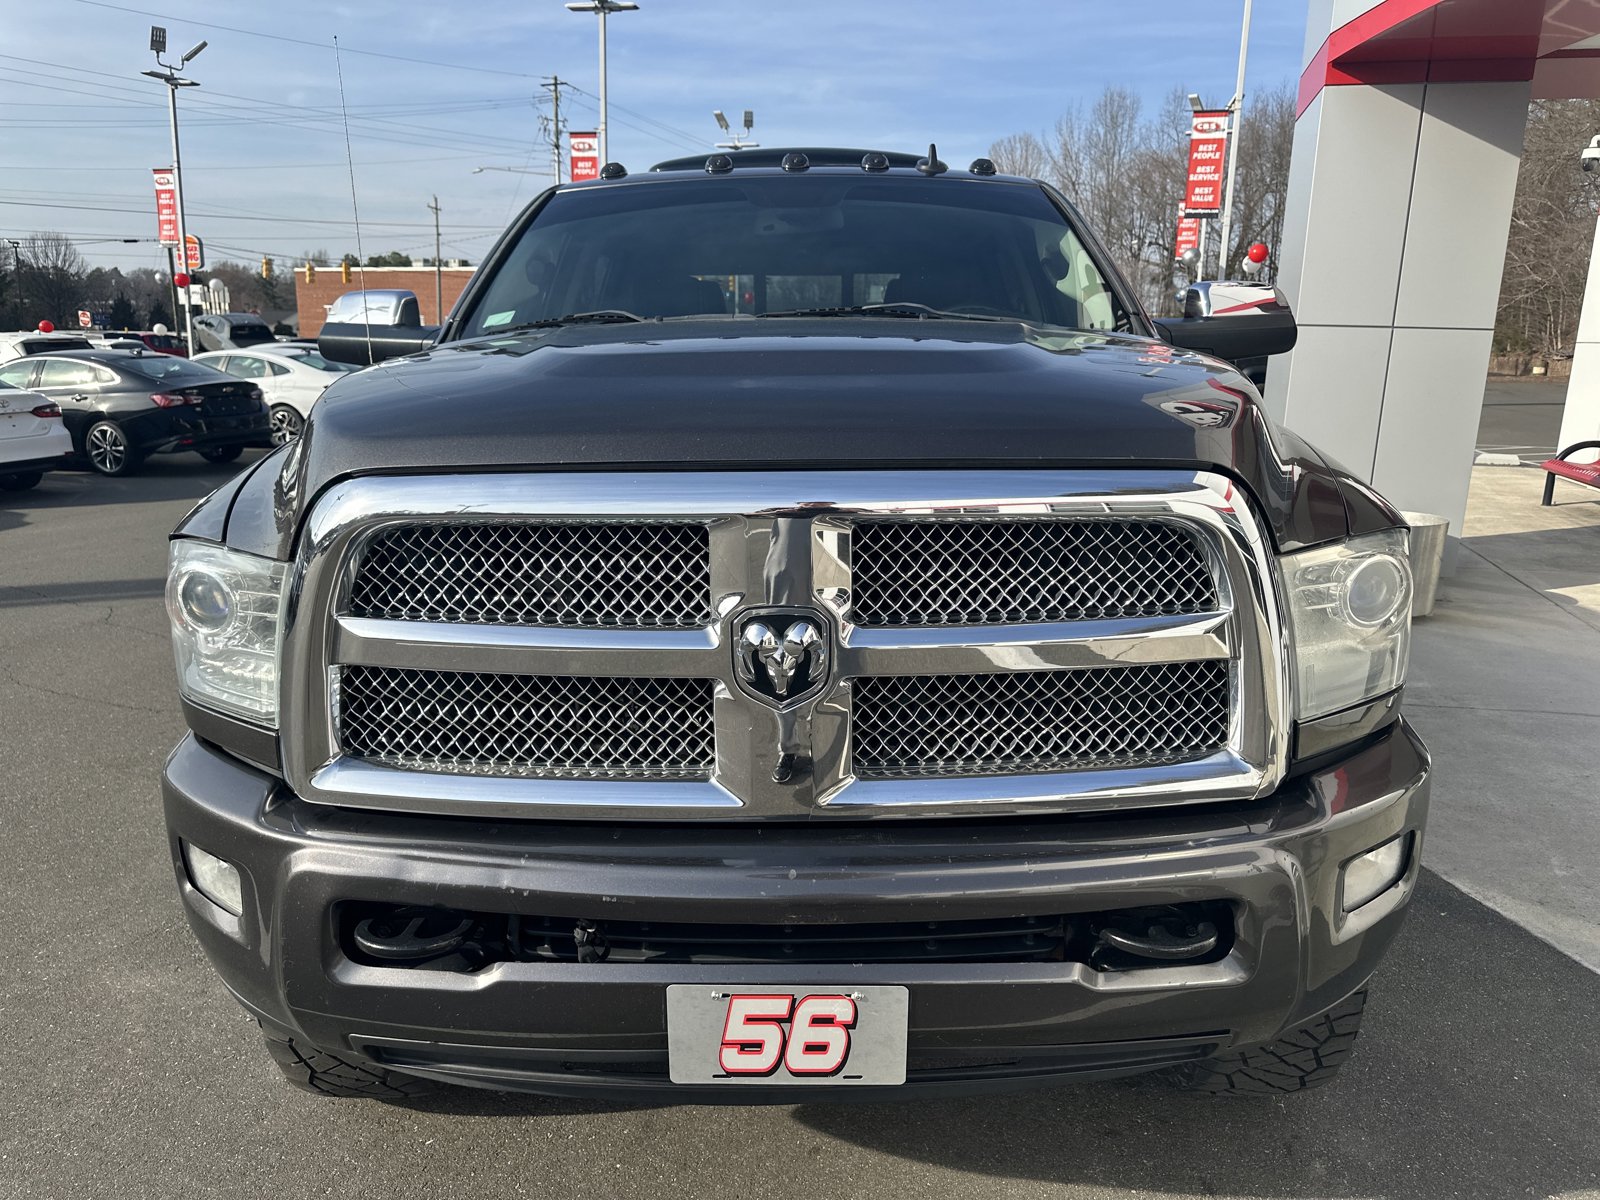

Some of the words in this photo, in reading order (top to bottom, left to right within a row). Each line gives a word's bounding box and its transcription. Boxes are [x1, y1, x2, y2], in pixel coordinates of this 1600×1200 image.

[1197, 143, 1218, 152] BEST
[1192, 151, 1221, 160] PEOPLE
[1195, 165, 1216, 173] BEST
[1188, 173, 1220, 181] SERVICE
[1193, 186, 1214, 195] BEST
[1191, 194, 1215, 203] VALUE
[718, 993, 859, 1078] 56
